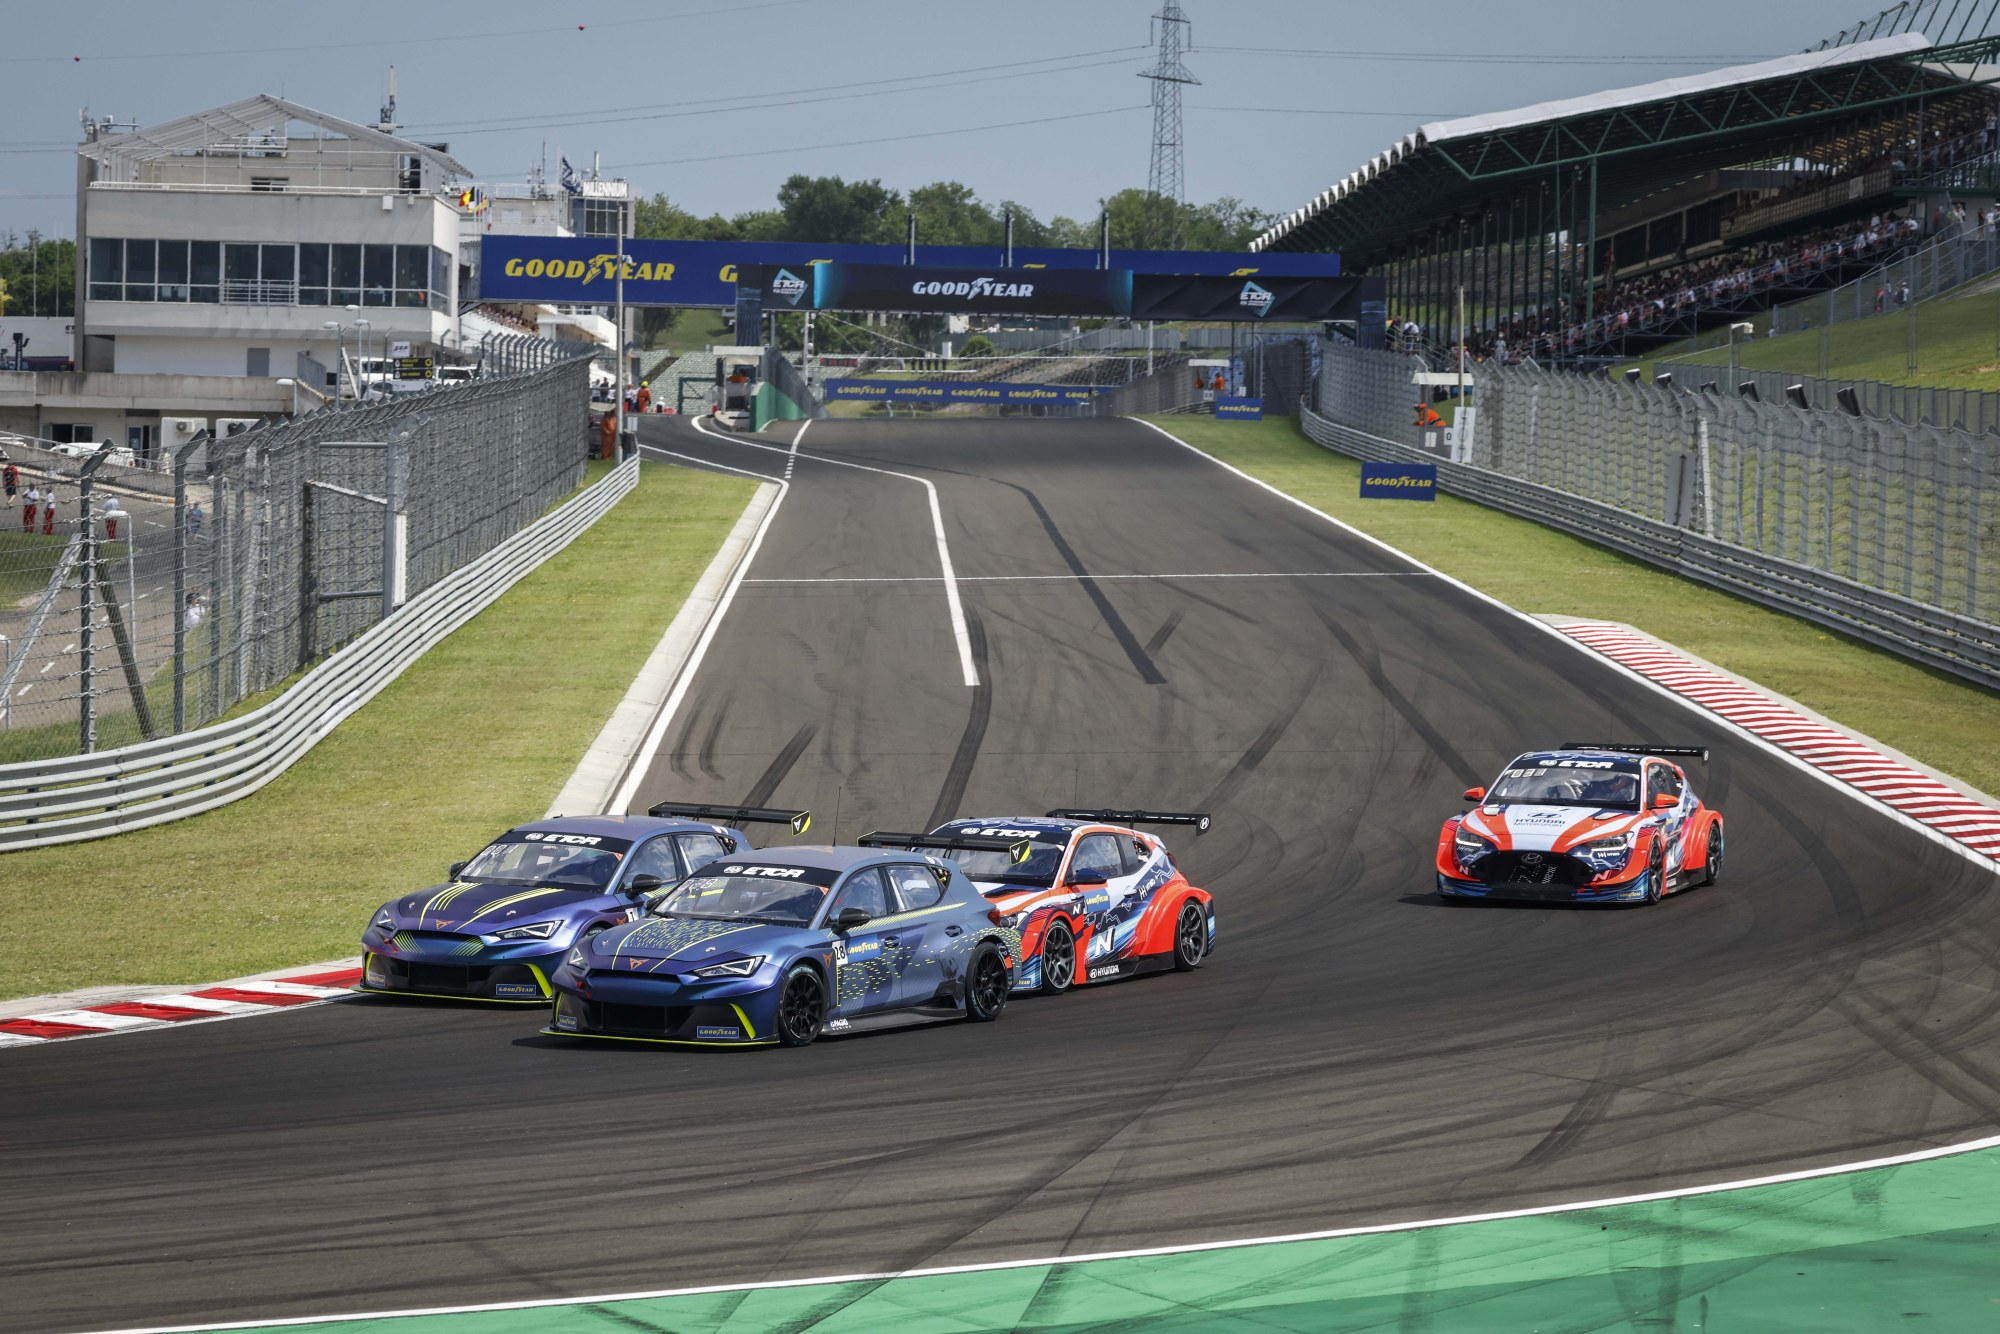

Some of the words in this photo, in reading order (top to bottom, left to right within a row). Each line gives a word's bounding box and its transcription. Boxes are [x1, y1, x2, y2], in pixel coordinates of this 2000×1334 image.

[912, 278, 1034, 299] GOODYEAR
[1366, 476, 1432, 488] GOODYEAR
[1558, 761, 1614, 769] ETCR
[980, 828, 1041, 838] ETCR
[542, 834, 602, 845] ETCR
[742, 867, 806, 878] ETCR
[1097, 965, 1120, 976] HYUNDAI
[498, 986, 534, 994] GOODYEAR
[700, 1028, 737, 1036] GOODYEAR
